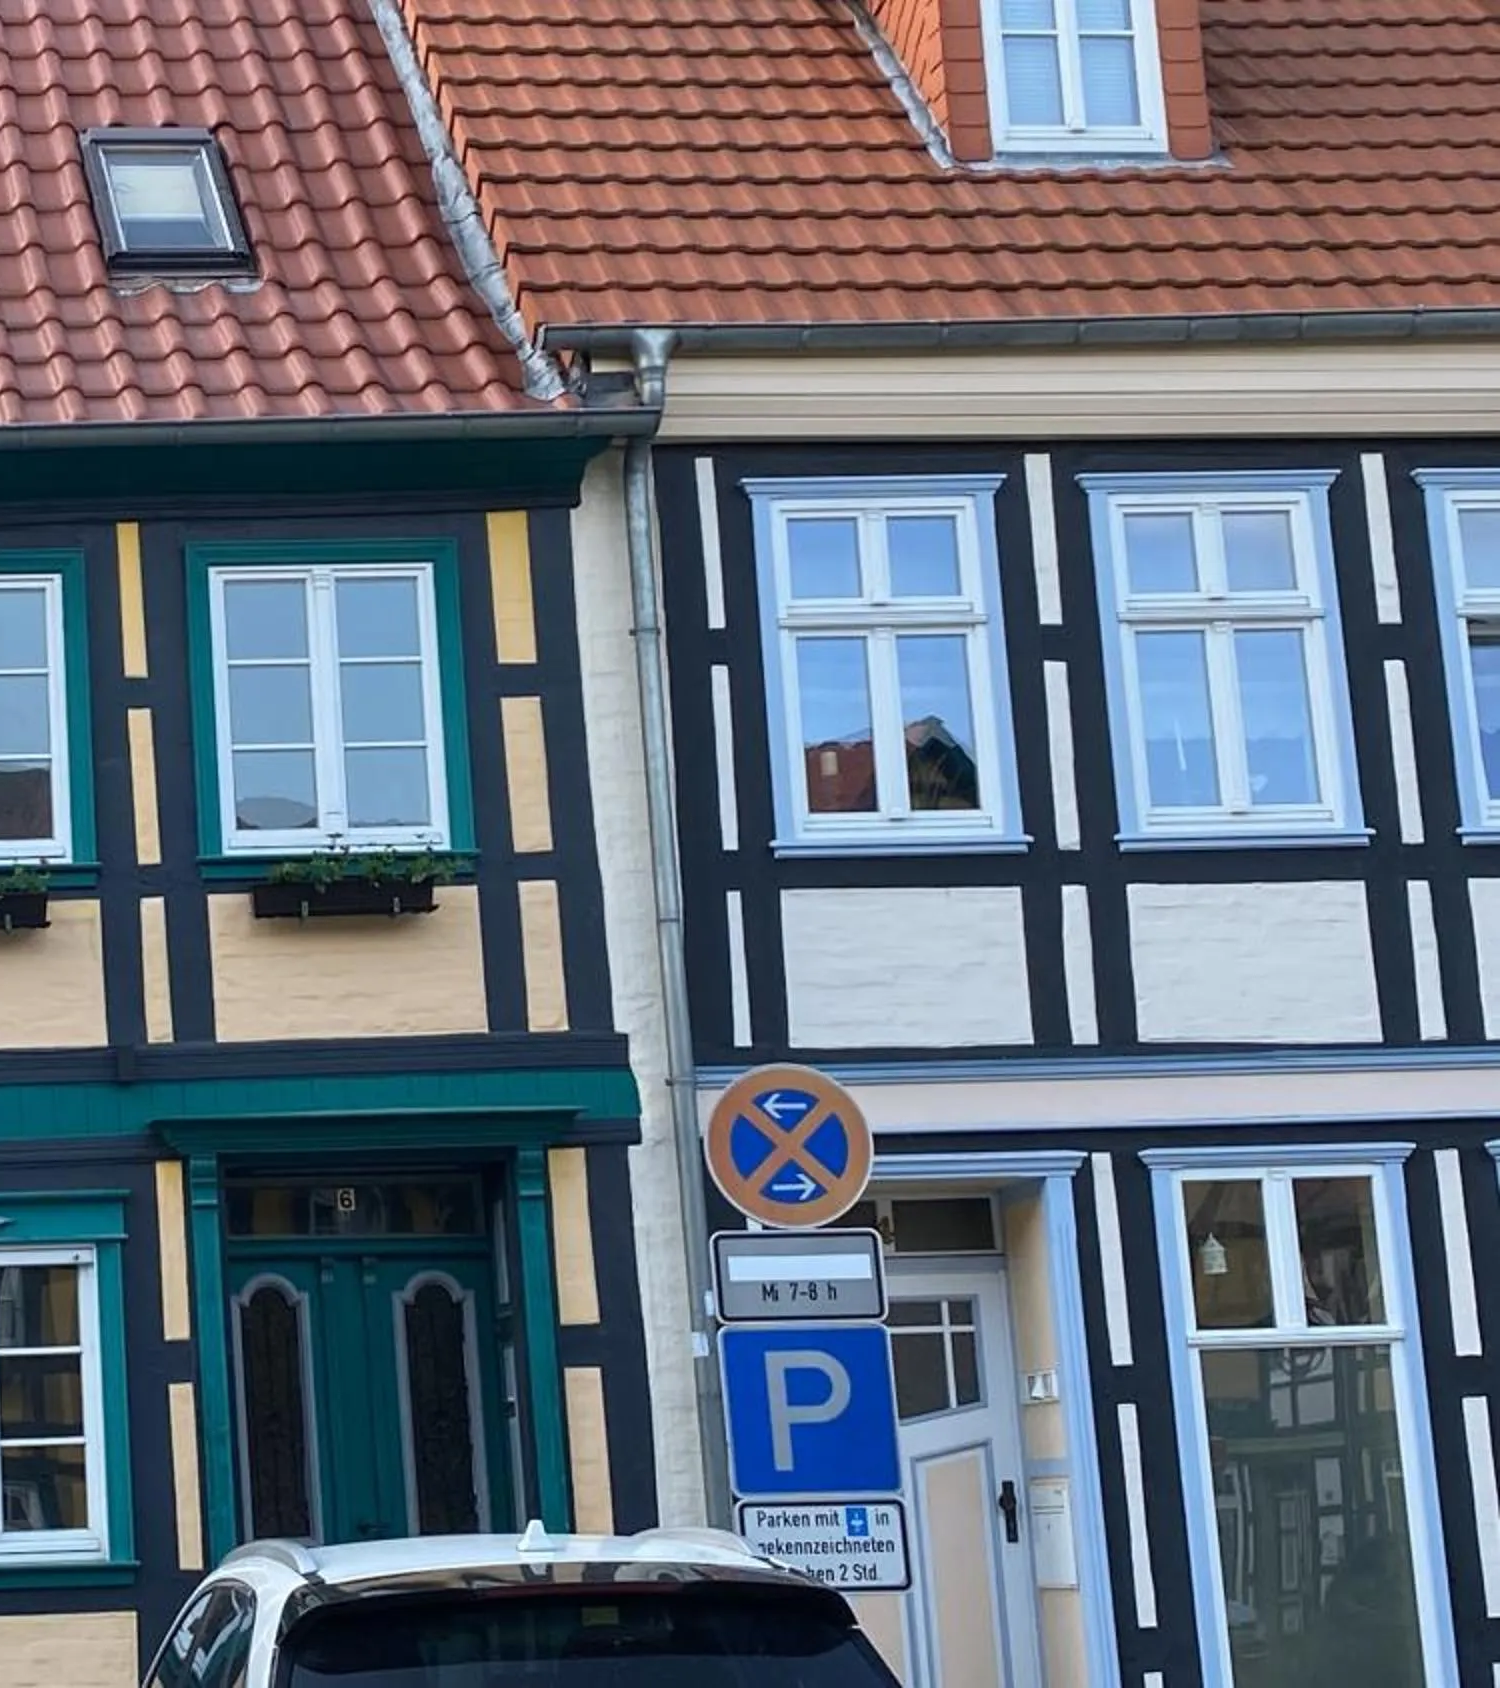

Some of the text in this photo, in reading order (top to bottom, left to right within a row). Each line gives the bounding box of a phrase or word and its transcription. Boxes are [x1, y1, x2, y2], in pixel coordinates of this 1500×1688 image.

[339, 1189, 352, 1209] 6
[762, 1281, 837, 1301] Mi 7-8 h
[764, 1350, 851, 1472] P
[756, 1508, 890, 1527] Parken mit in
[839, 1564, 849, 1582] 2
